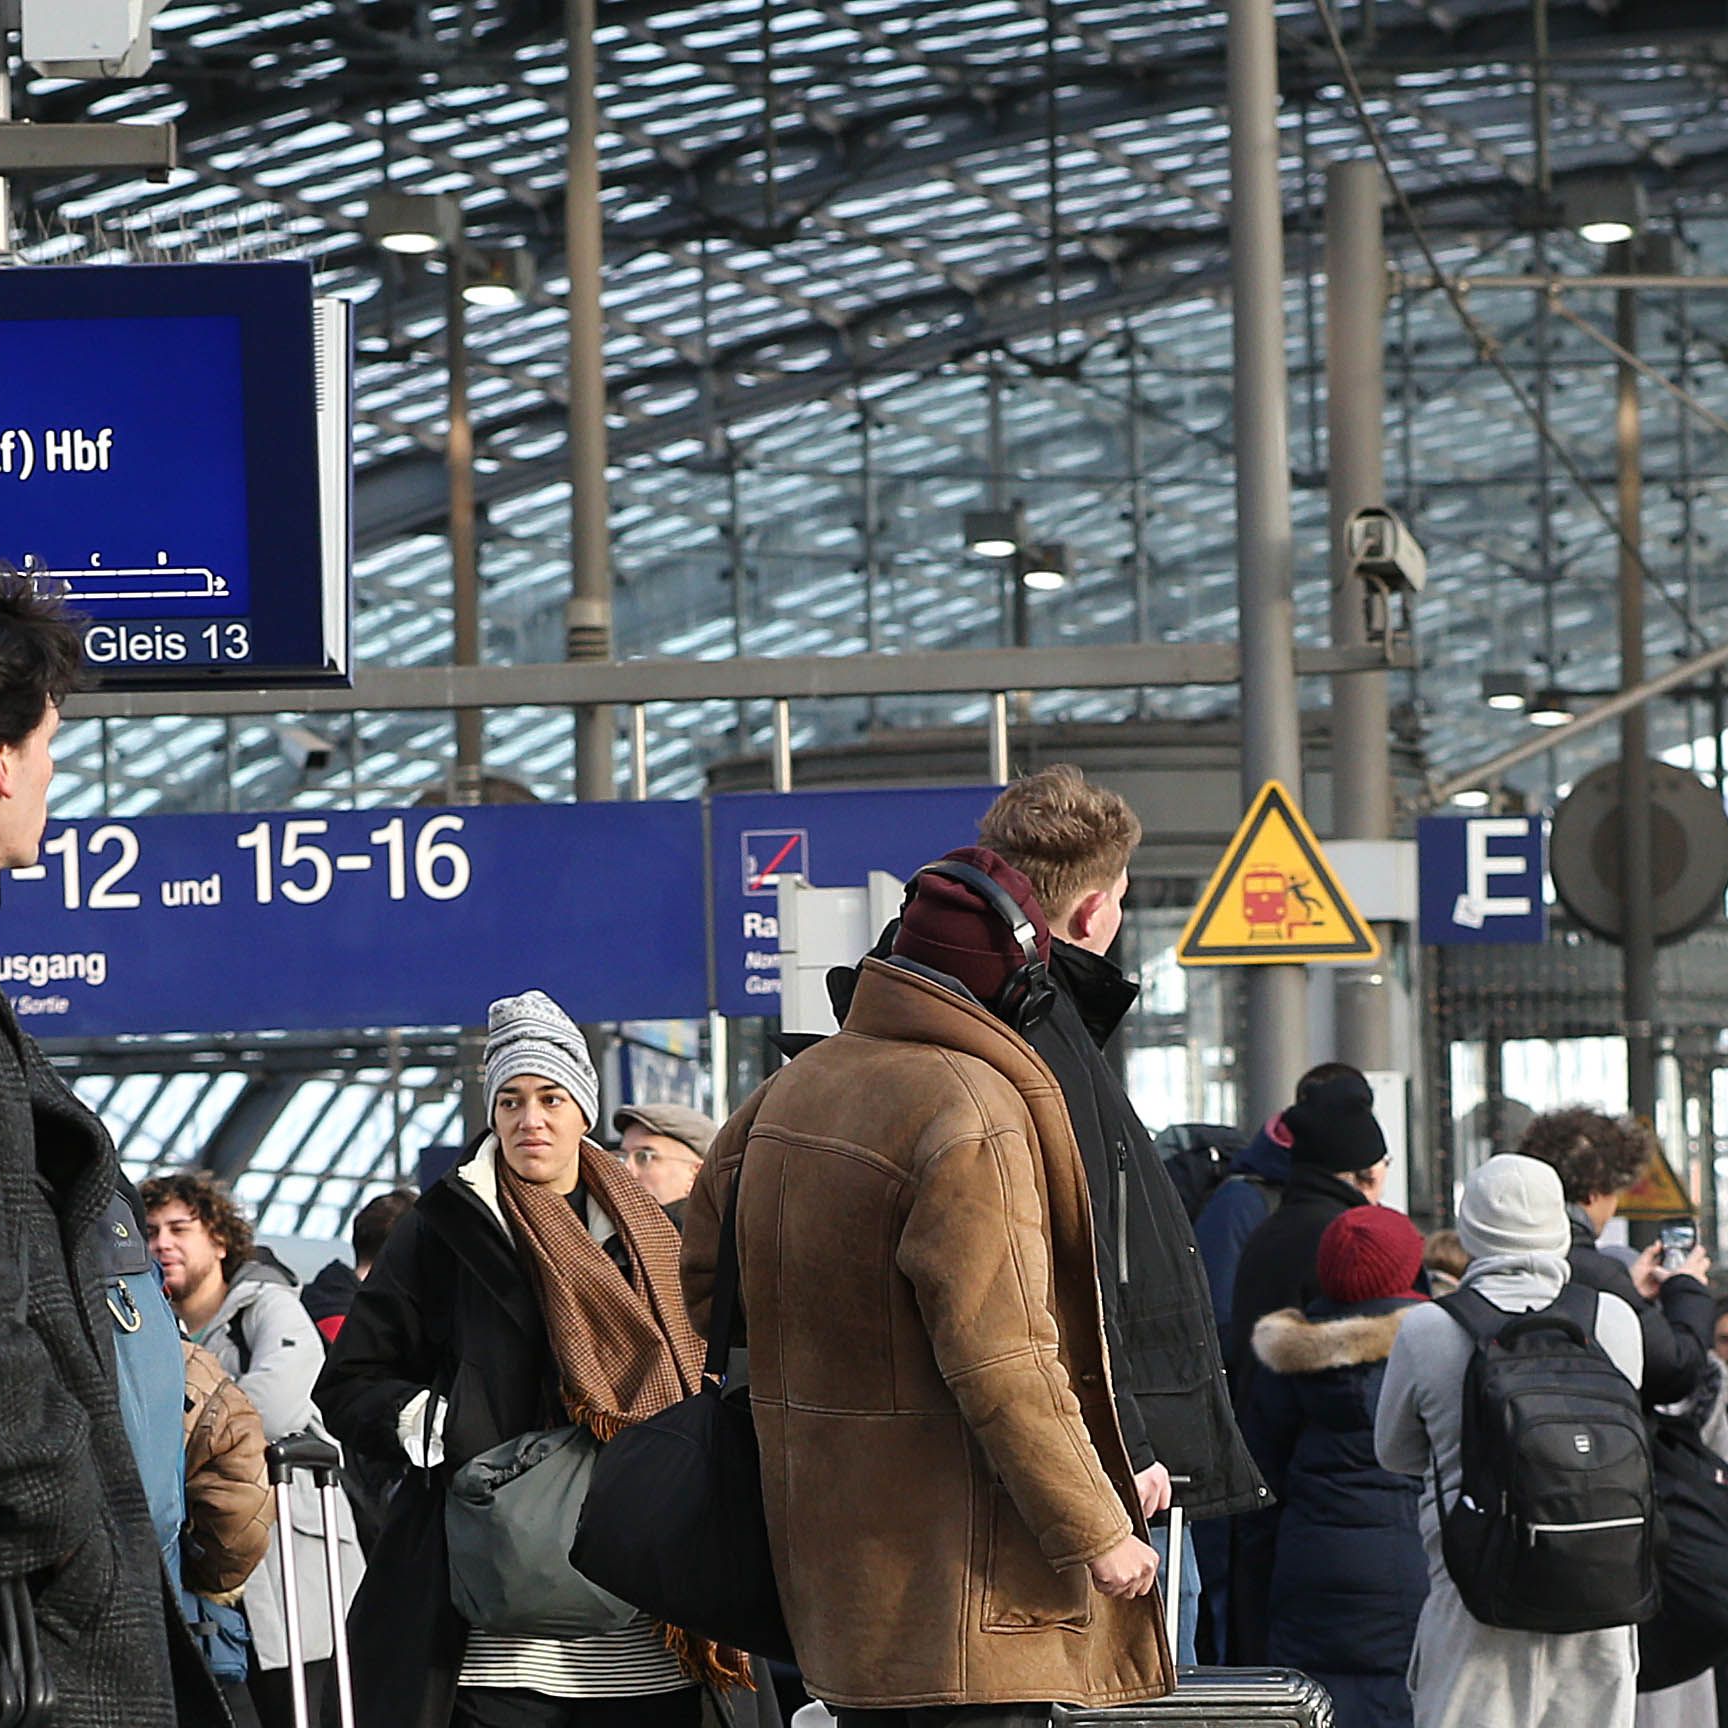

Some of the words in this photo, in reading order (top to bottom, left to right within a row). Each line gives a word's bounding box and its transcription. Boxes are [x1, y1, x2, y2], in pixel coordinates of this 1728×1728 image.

[45, 428, 113, 472] Hbf
[90, 552, 101, 567] C
[84, 625, 187, 663] Gleis
[201, 623, 250, 660] 13
[161, 873, 221, 907] und
[237, 814, 472, 905] 15-16
[1466, 818, 1531, 917] E
[17, 994, 70, 1015] Sortie
